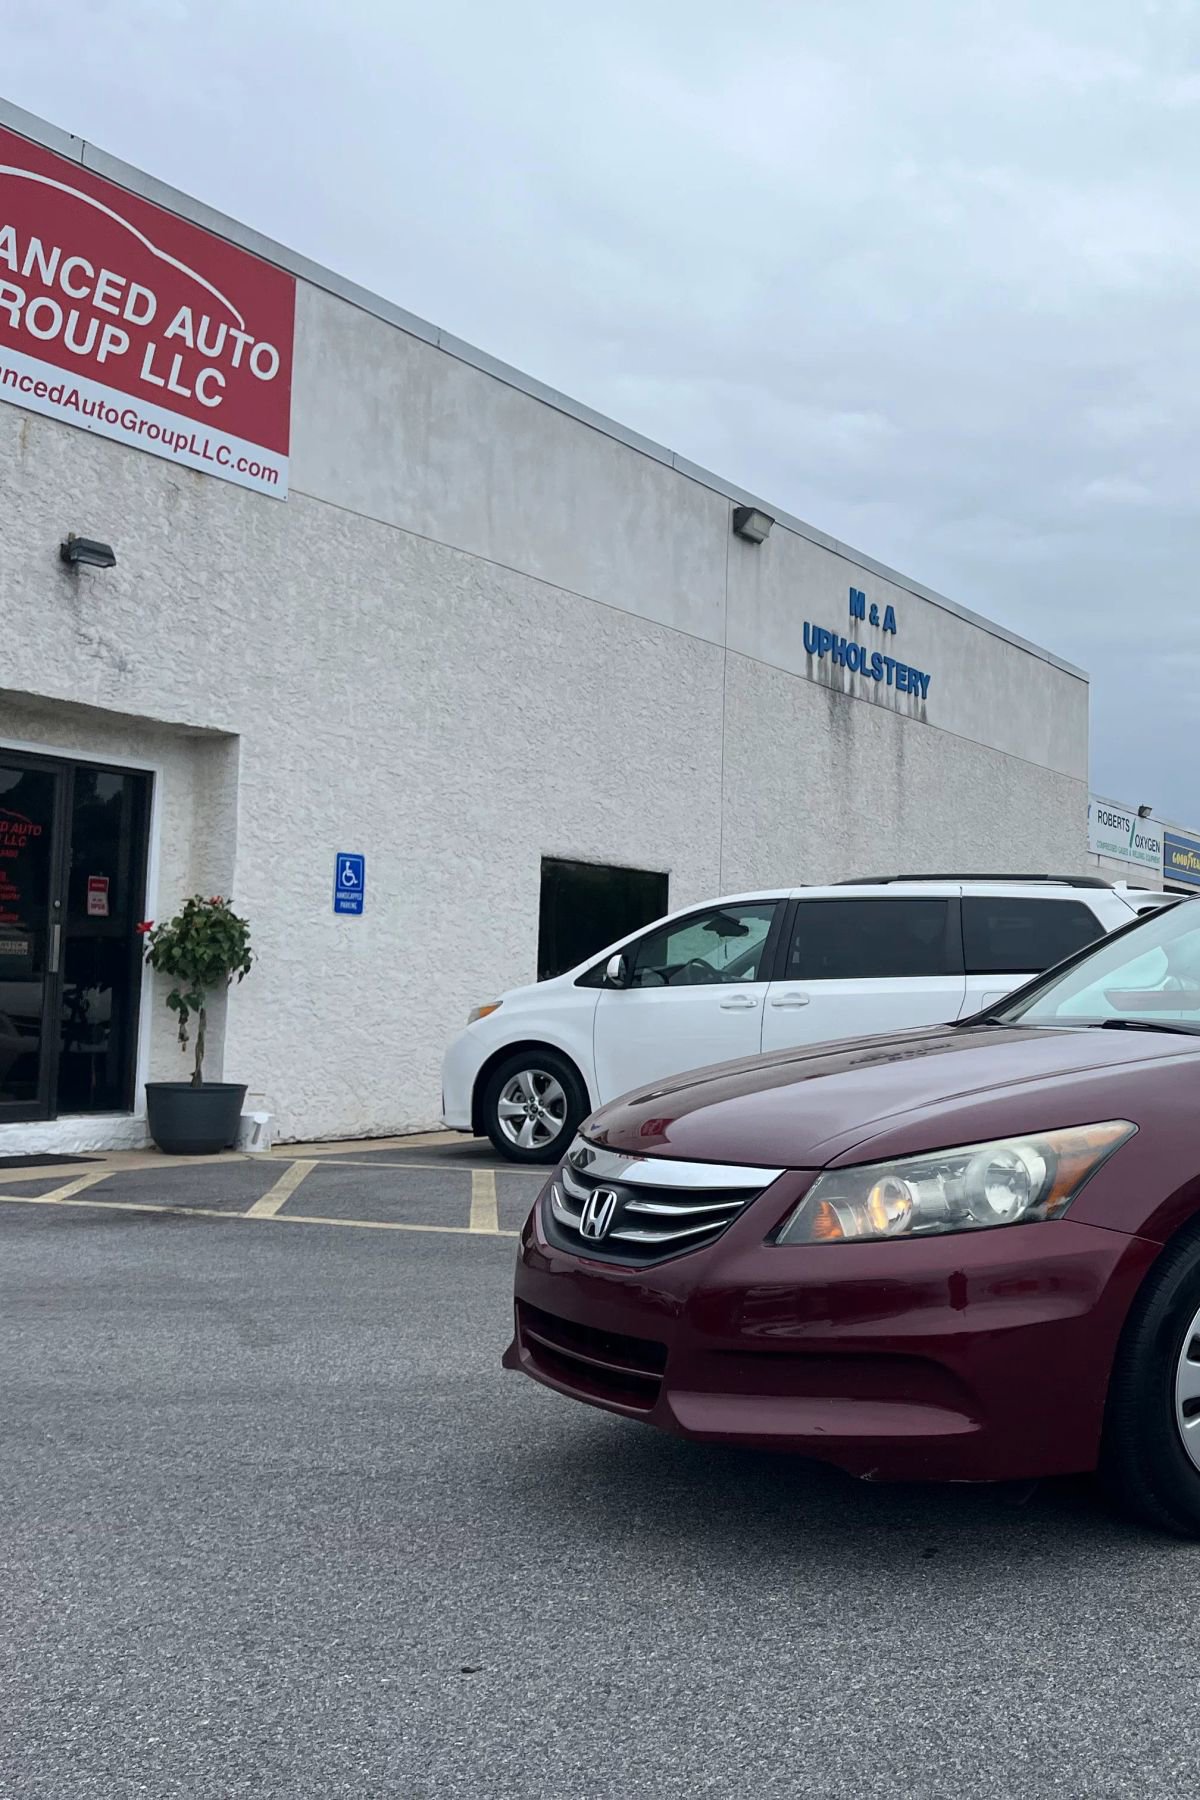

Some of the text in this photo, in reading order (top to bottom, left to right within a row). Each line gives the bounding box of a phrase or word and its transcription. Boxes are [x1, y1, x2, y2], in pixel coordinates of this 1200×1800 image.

[140, 343, 226, 408] LLC
[164, 306, 280, 381] AUTO
[0, 365, 279, 485] ncedAutoGroupLLC.com
[849, 586, 897, 635] M & A
[803, 621, 931, 700] UPHOLSTERY
[1097, 809, 1130, 833] ROBERTS
[1134, 834, 1160, 853] OXYGEN
